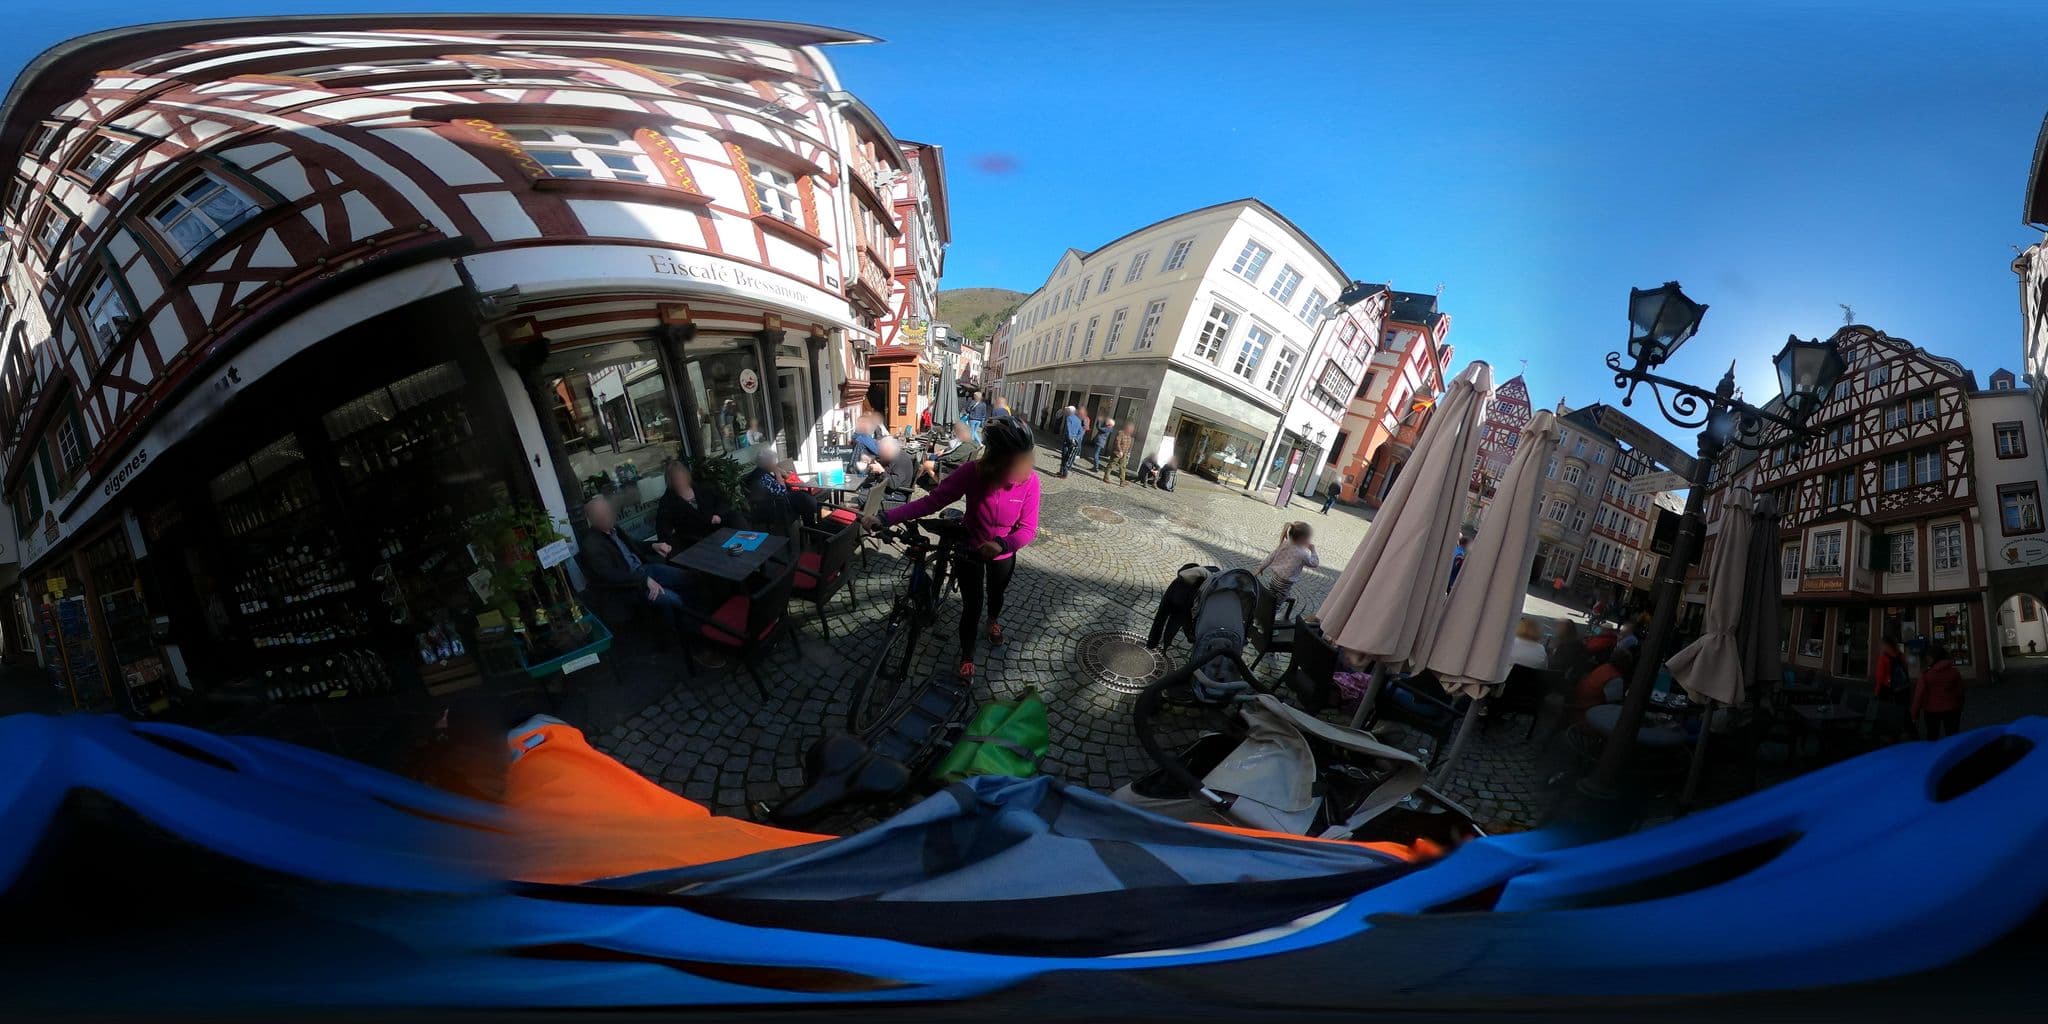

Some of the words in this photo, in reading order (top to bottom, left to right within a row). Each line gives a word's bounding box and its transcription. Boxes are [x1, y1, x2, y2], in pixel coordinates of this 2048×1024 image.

[648, 254, 729, 283] Eiscafé
[733, 268, 809, 304] Bressanone
[104, 449, 147, 496] eigenes
